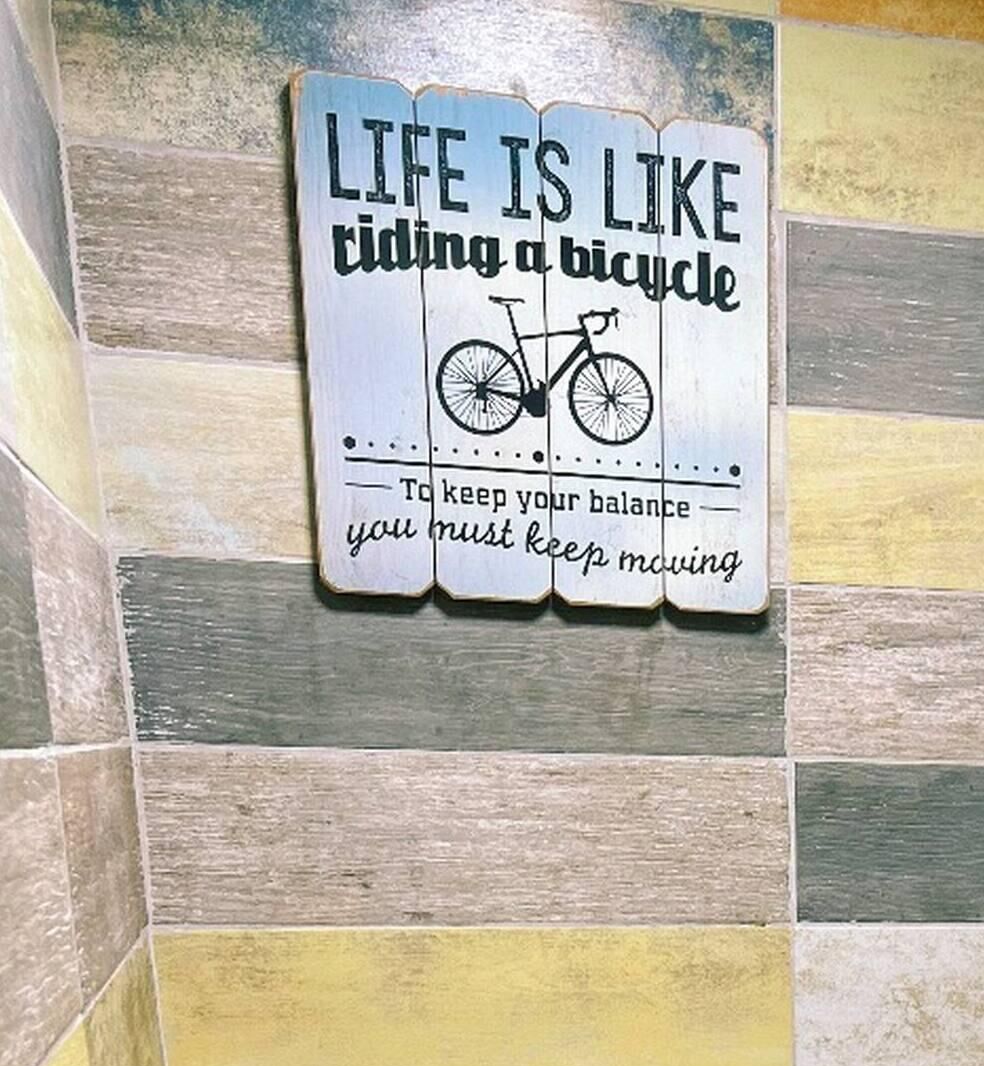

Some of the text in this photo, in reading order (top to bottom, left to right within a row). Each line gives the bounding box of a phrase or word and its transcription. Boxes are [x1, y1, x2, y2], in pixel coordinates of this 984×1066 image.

[326, 112, 741, 244] LIFE IS LIKE
[331, 213, 740, 312] riding a bicycle
[400, 478, 690, 518] To keep your balance
[346, 516, 742, 582] you must keep moving
